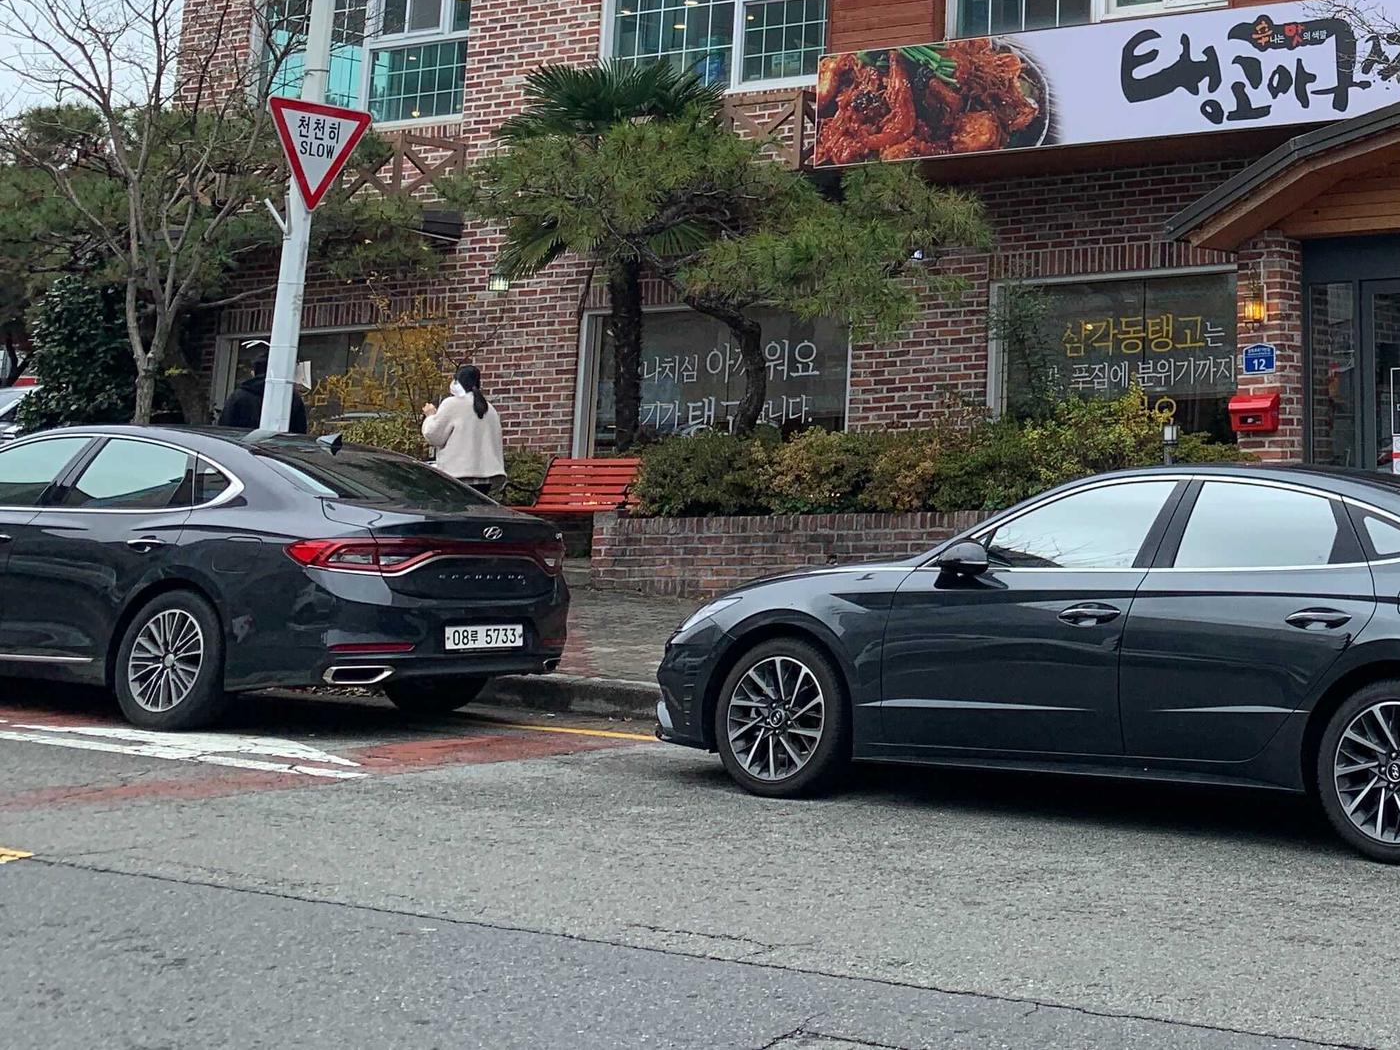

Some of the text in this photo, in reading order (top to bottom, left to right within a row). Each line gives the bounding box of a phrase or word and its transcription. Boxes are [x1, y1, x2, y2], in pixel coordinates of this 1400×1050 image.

[298, 115, 341, 144] 천천히
[299, 140, 335, 159] SLOW
[1062, 313, 1225, 357] 삼각동탱고는
[639, 354, 698, 384] 나치심
[1136, 354, 1235, 388] 분위기까지
[1252, 358, 1266, 371] 12
[639, 400, 682, 430] 기가
[452, 627, 517, 647] 08루 5733
